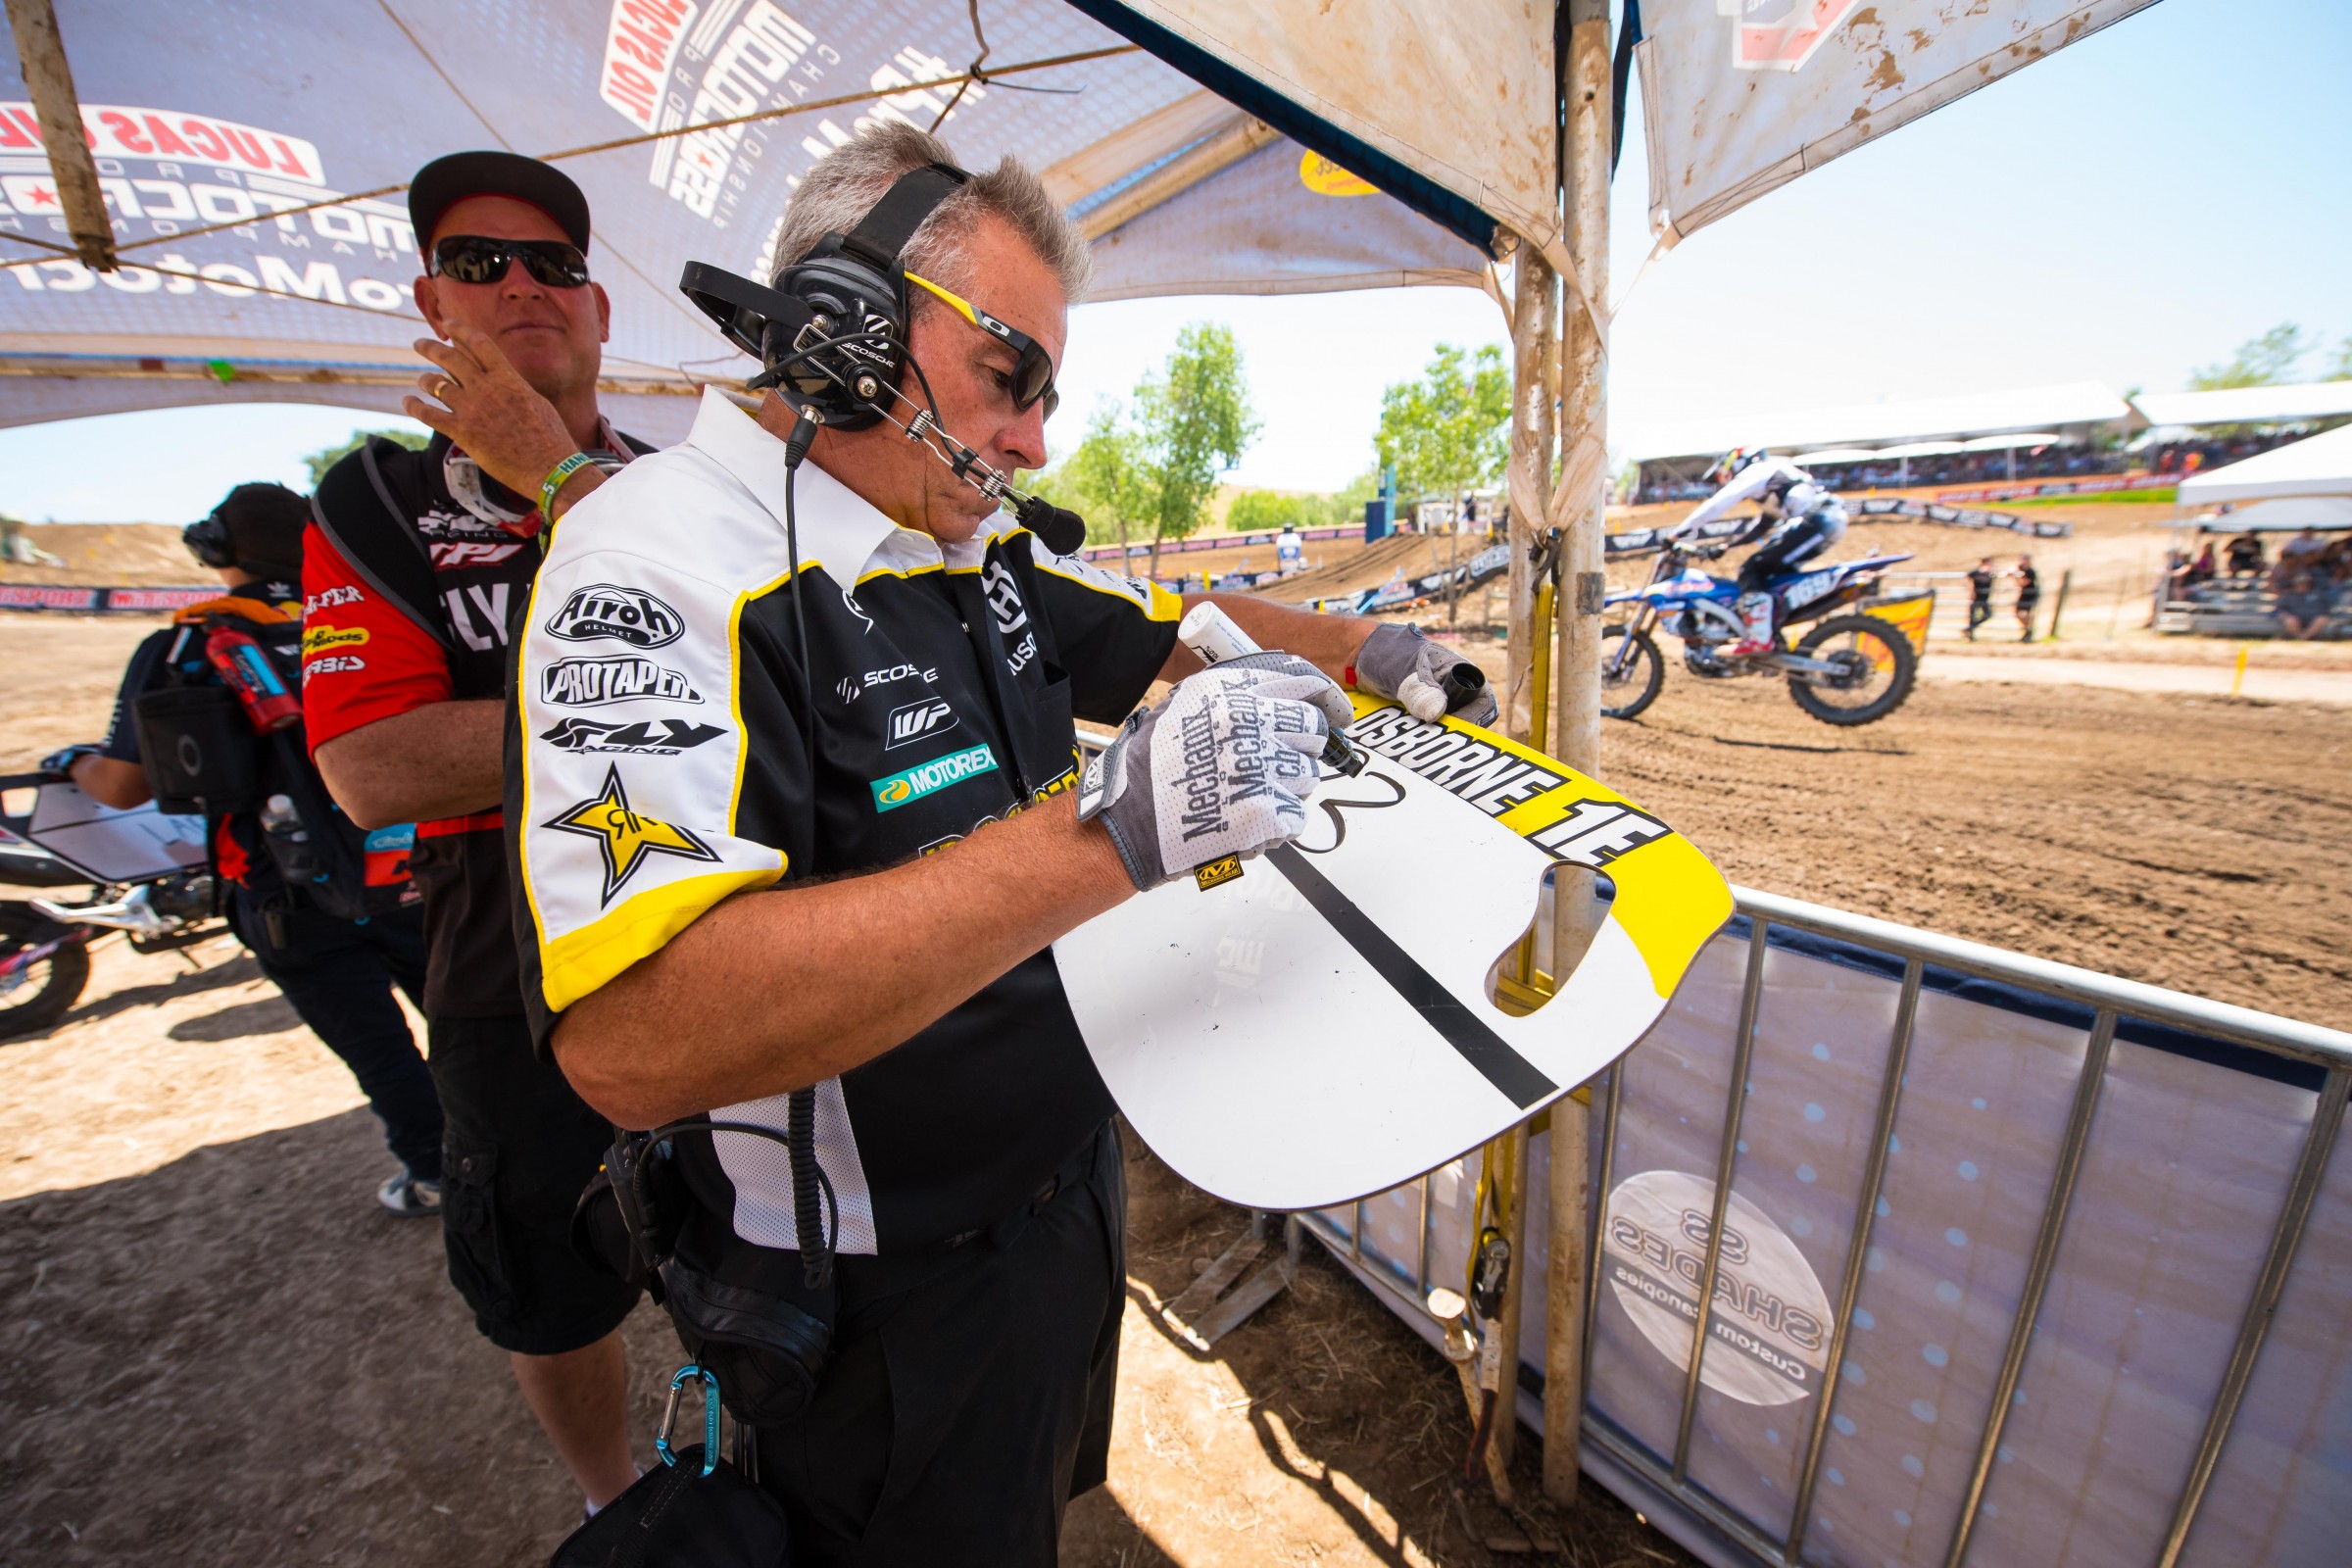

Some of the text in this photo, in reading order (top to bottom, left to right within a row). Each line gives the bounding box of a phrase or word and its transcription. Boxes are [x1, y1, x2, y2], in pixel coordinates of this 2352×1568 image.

[585, 623, 632, 639] HELMET
[908, 747, 997, 795] MOTOREX
[1344, 703, 1573, 818] OSBORNE
